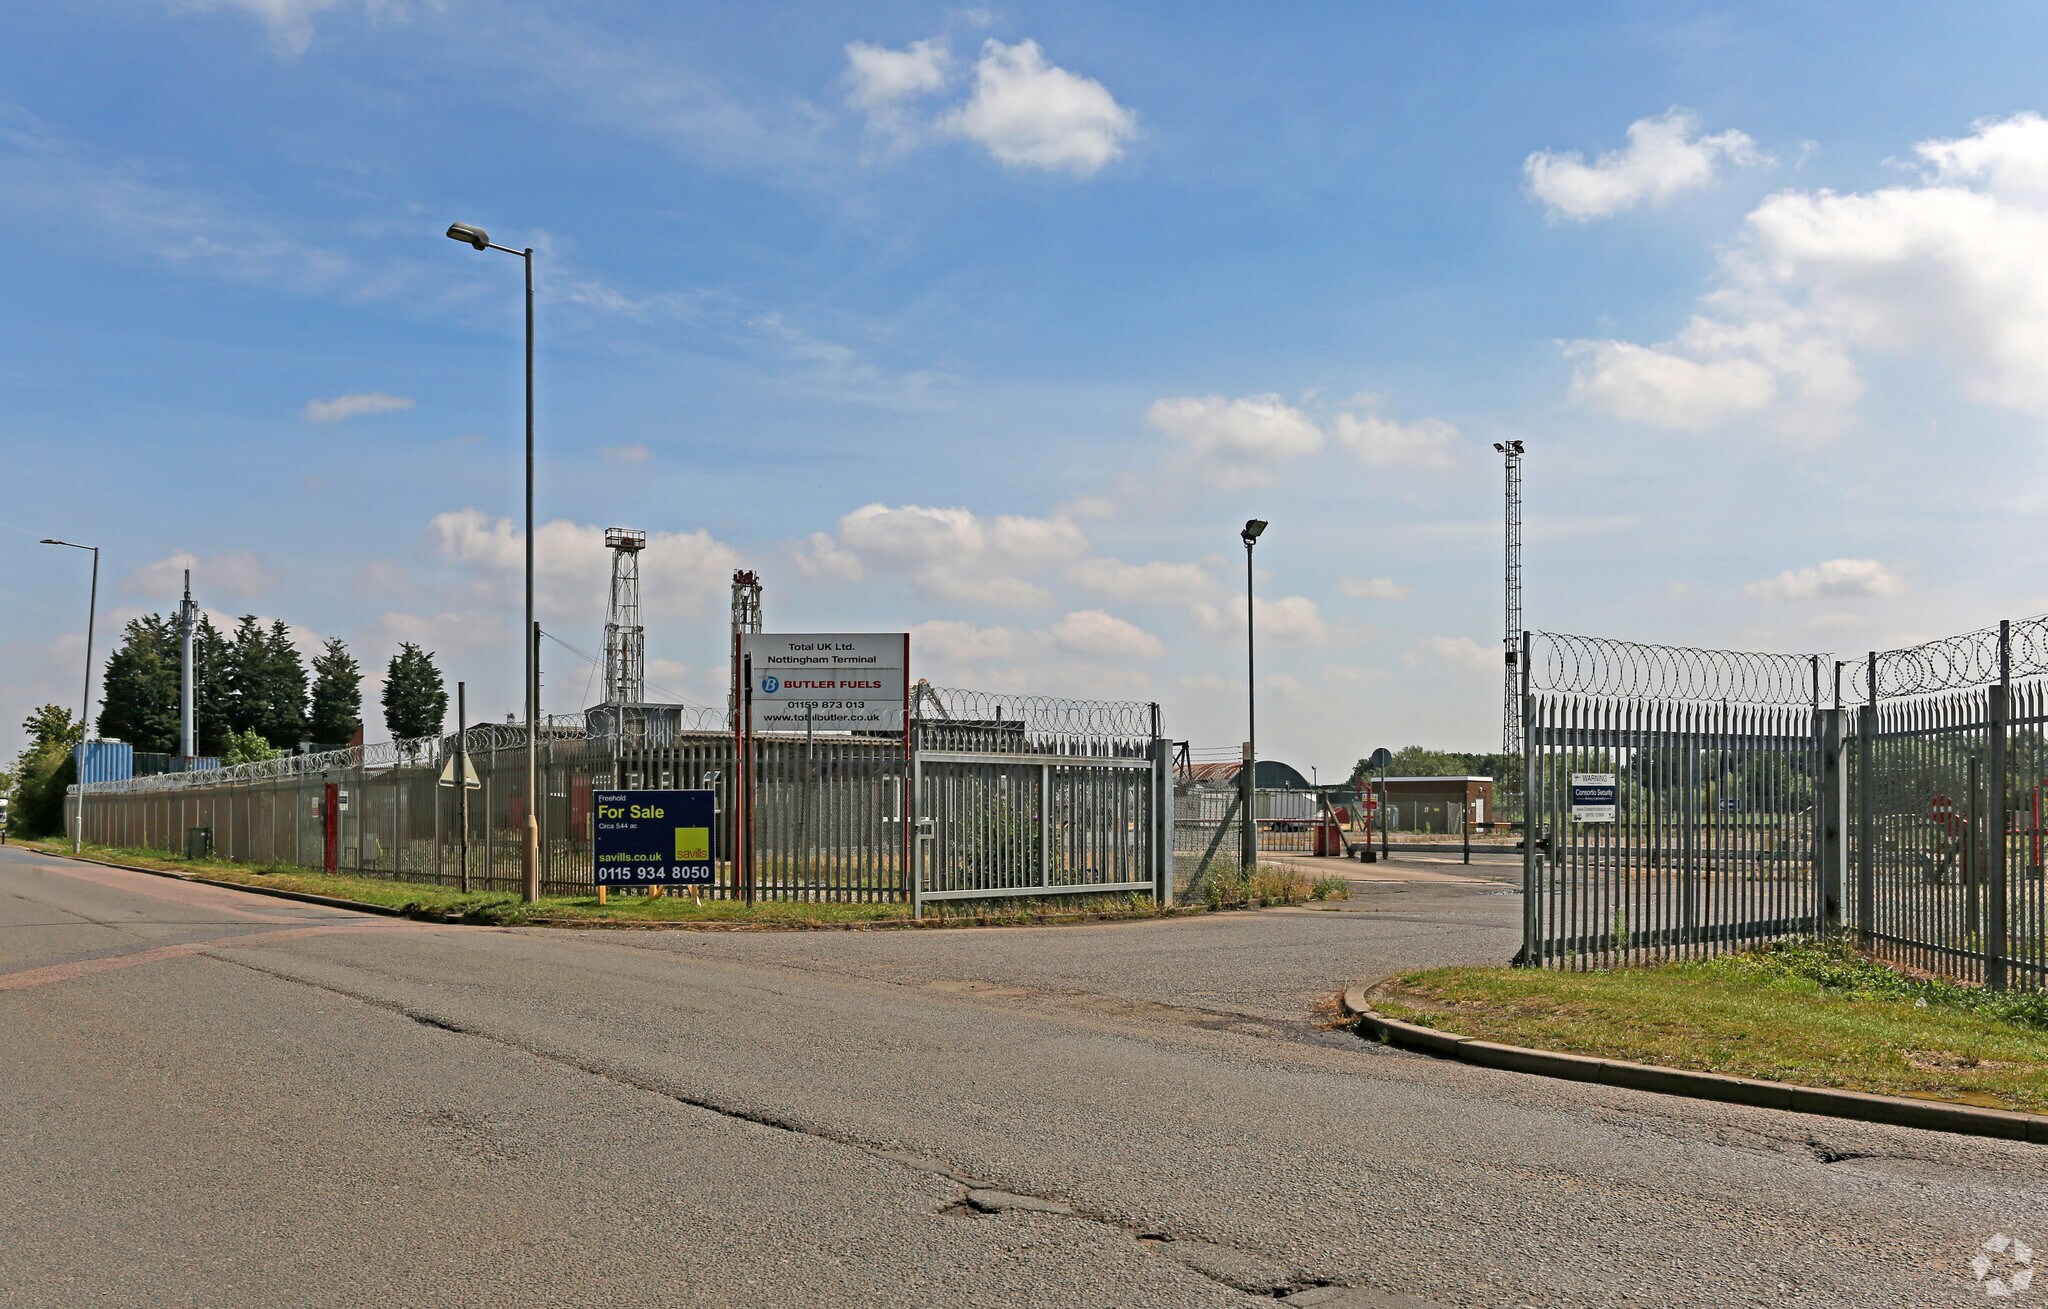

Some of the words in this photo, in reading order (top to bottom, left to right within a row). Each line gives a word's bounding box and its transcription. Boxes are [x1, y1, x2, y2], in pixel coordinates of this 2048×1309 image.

[788, 643, 814, 651] Total
[817, 643, 832, 651] UK
[835, 643, 855, 651] Ltd.
[768, 656, 829, 665] Nottingham
[832, 656, 876, 664] Terminal
[784, 681, 835, 689] BUTLER
[840, 681, 882, 689] FUELS
[788, 701, 818, 709] 01159
[822, 701, 843, 709] 873
[846, 701, 865, 709] 013
[1597, 789, 1613, 797] Security
[598, 805, 625, 819] For
[630, 805, 665, 819] Sale
[599, 852, 662, 862] savills.co.uk
[677, 849, 708, 859] savills
[599, 867, 631, 880] 0115
[637, 867, 666, 879] 934
[672, 866, 709, 879] 8050
